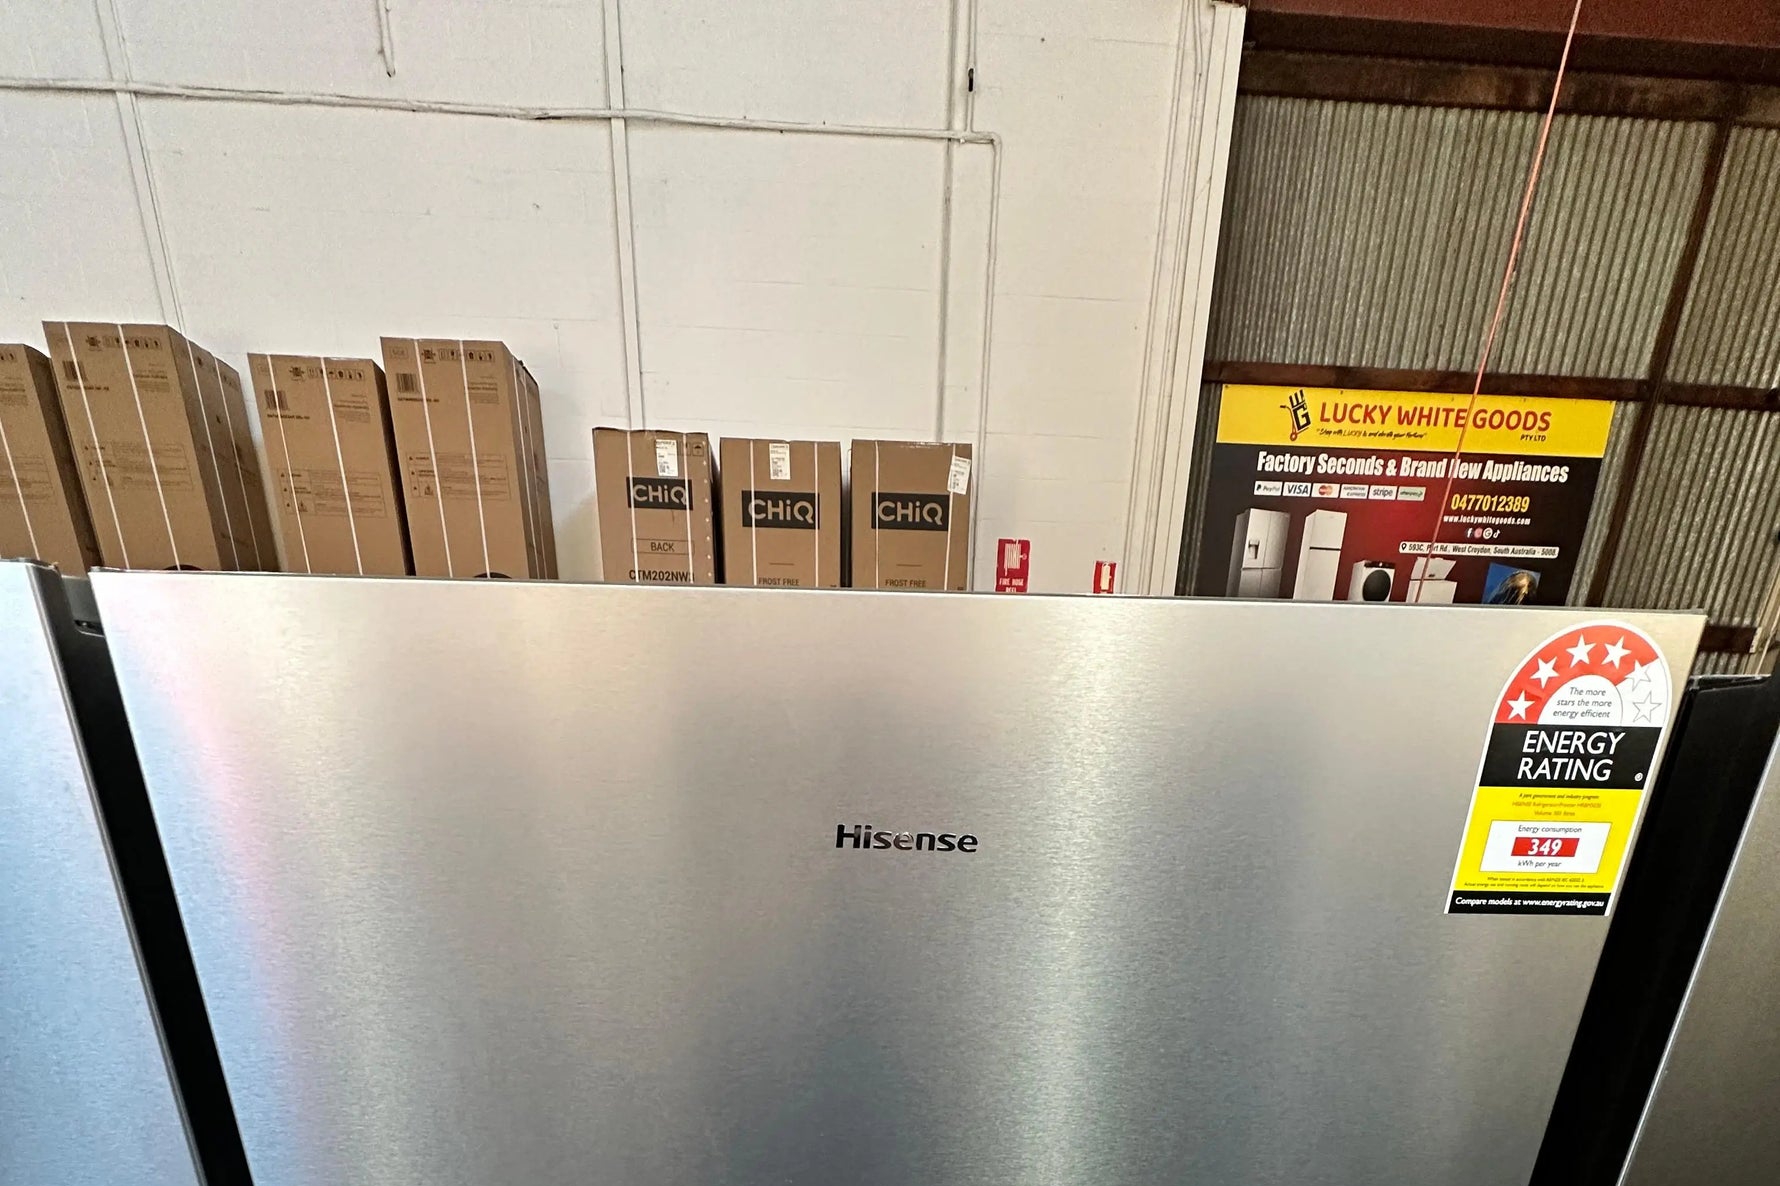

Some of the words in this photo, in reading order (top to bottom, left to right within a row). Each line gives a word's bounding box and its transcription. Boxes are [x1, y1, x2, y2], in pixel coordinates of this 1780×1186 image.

[1319, 402, 1393, 425] LUCKY
[1397, 406, 1468, 428] WHITE
[1472, 408, 1552, 432] GOODS
[1256, 451, 1316, 475] Factory
[1317, 453, 1384, 476] Seconds
[1385, 458, 1397, 476] &
[1400, 456, 1448, 478] Brand
[1482, 460, 1570, 483] Appliances
[631, 484, 687, 505] CHiQ
[1287, 484, 1309, 495] VISA
[1372, 487, 1394, 498] stripe
[1450, 493, 1530, 513] 0477012389
[748, 498, 814, 524] CHiQ
[877, 501, 943, 525] CHiQ
[1443, 514, 1531, 526] www.luckywhitegoods.com
[650, 541, 675, 552] BACK
[1426, 543, 1438, 553] Prt
[1452, 545, 1466, 553] West
[1493, 546, 1510, 555] South
[1511, 547, 1536, 556] Australia
[758, 577, 781, 586] FROST
[783, 578, 799, 587] FREE
[885, 578, 907, 587] FROST
[909, 579, 926, 588] FREE
[1569, 687, 1584, 696] The
[1585, 688, 1606, 696] more
[1556, 699, 1575, 707] stars
[1577, 698, 1590, 707] the
[1591, 699, 1612, 707] more
[1552, 710, 1578, 719] energy
[1580, 709, 1610, 718] efficient
[1522, 730, 1626, 755] ENERGY
[1516, 757, 1614, 781] RATING
[1518, 824, 1540, 834] Energy
[1541, 826, 1582, 834] consumption
[835, 824, 979, 853] Hisense
[1527, 837, 1563, 856] 349
[1517, 860, 1534, 868] kWh
[1455, 896, 1488, 906] Compare
[1488, 897, 1513, 906] models
[1522, 899, 1605, 909] www.energyrating.gov.au
